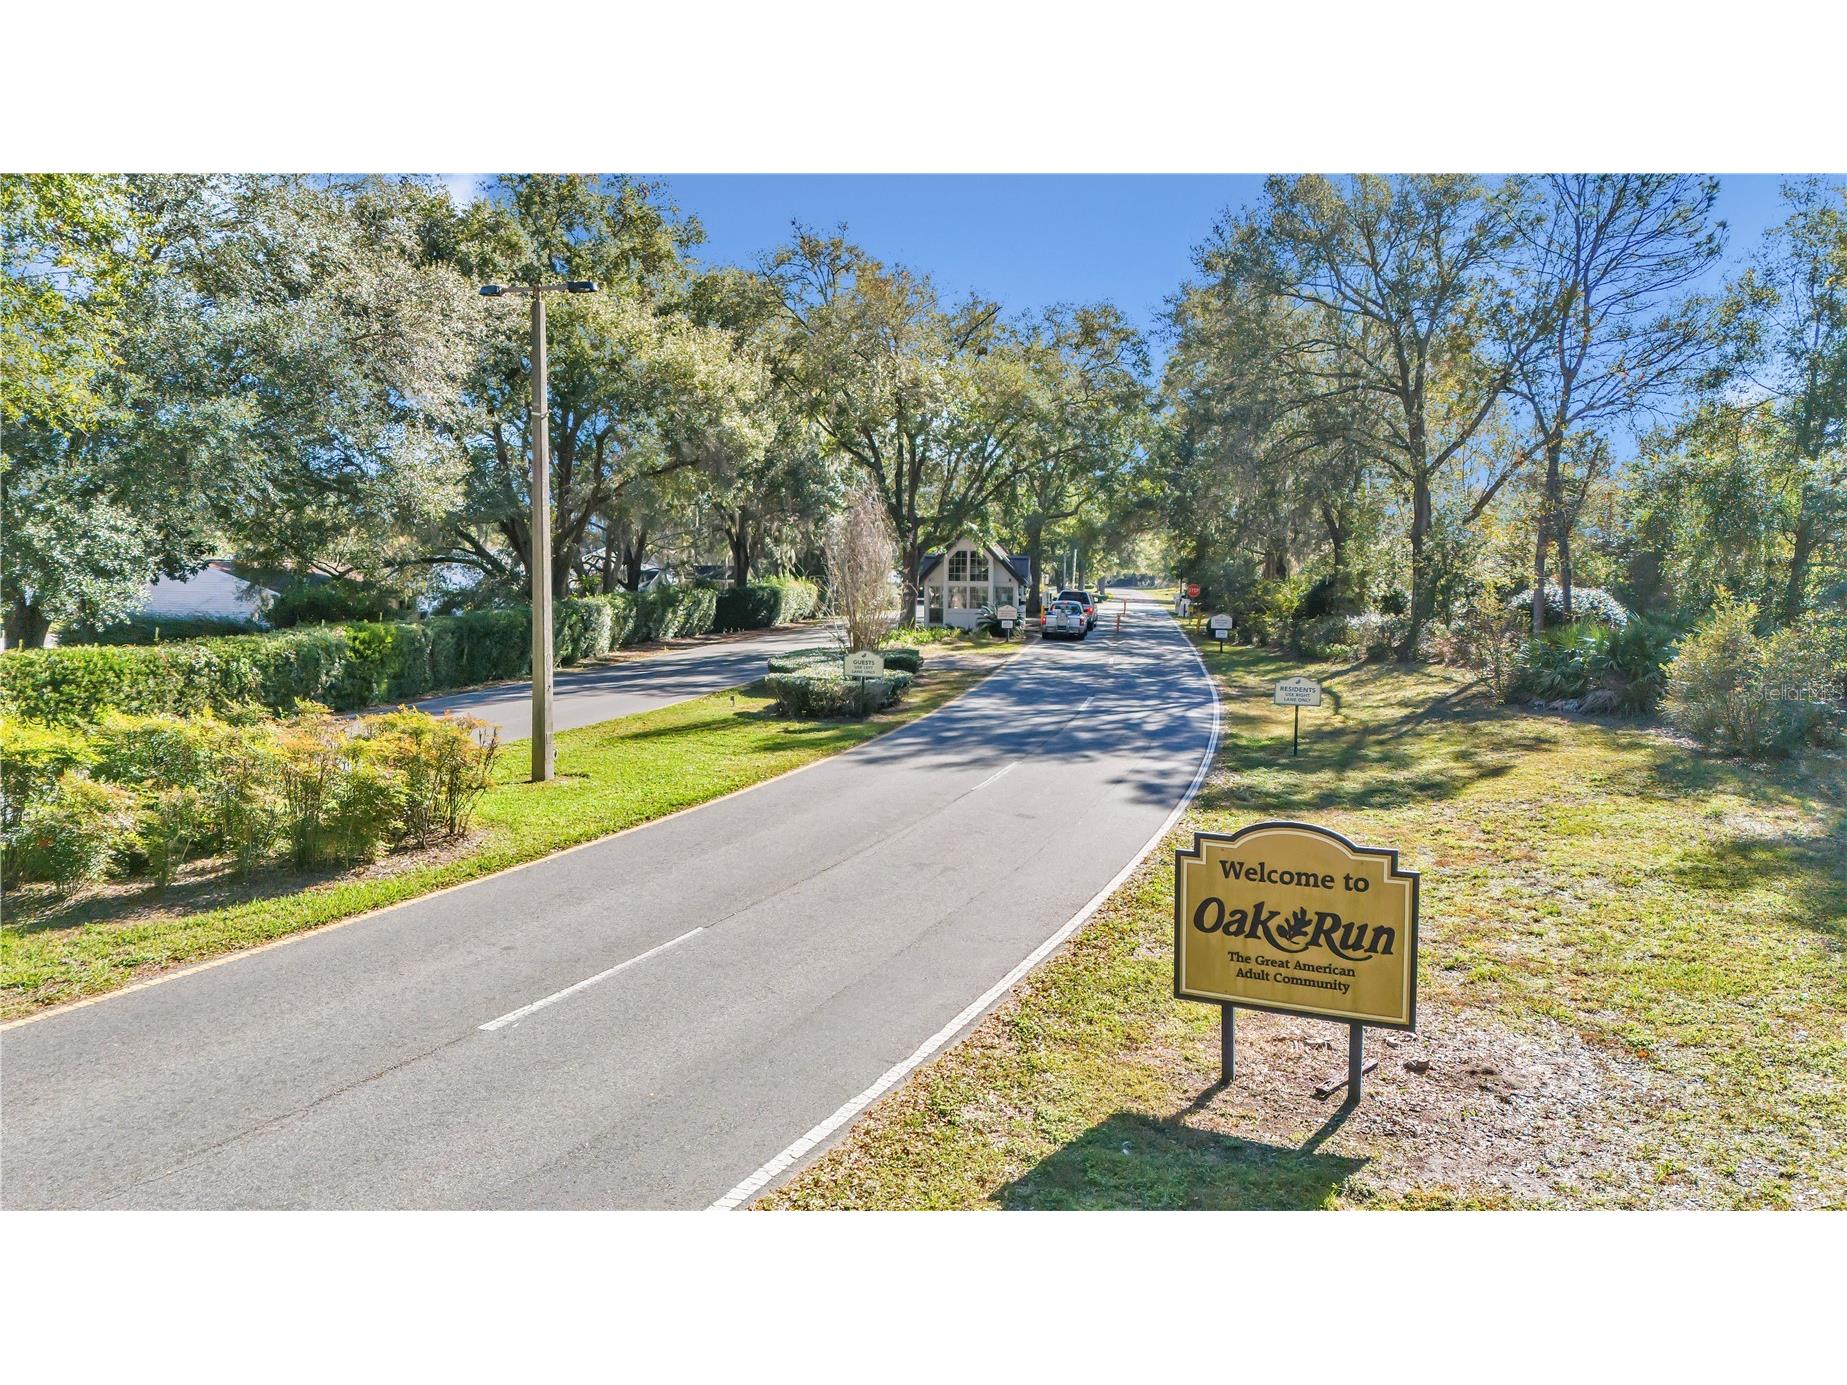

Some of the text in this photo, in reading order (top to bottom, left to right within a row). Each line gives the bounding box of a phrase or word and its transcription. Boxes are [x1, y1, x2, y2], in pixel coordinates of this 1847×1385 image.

[1219, 860, 1370, 893] Welcome to
[1193, 896, 1396, 962] Oak Run
[1227, 951, 1356, 977] The Great American
[1236, 967, 1351, 995] Adult Community
